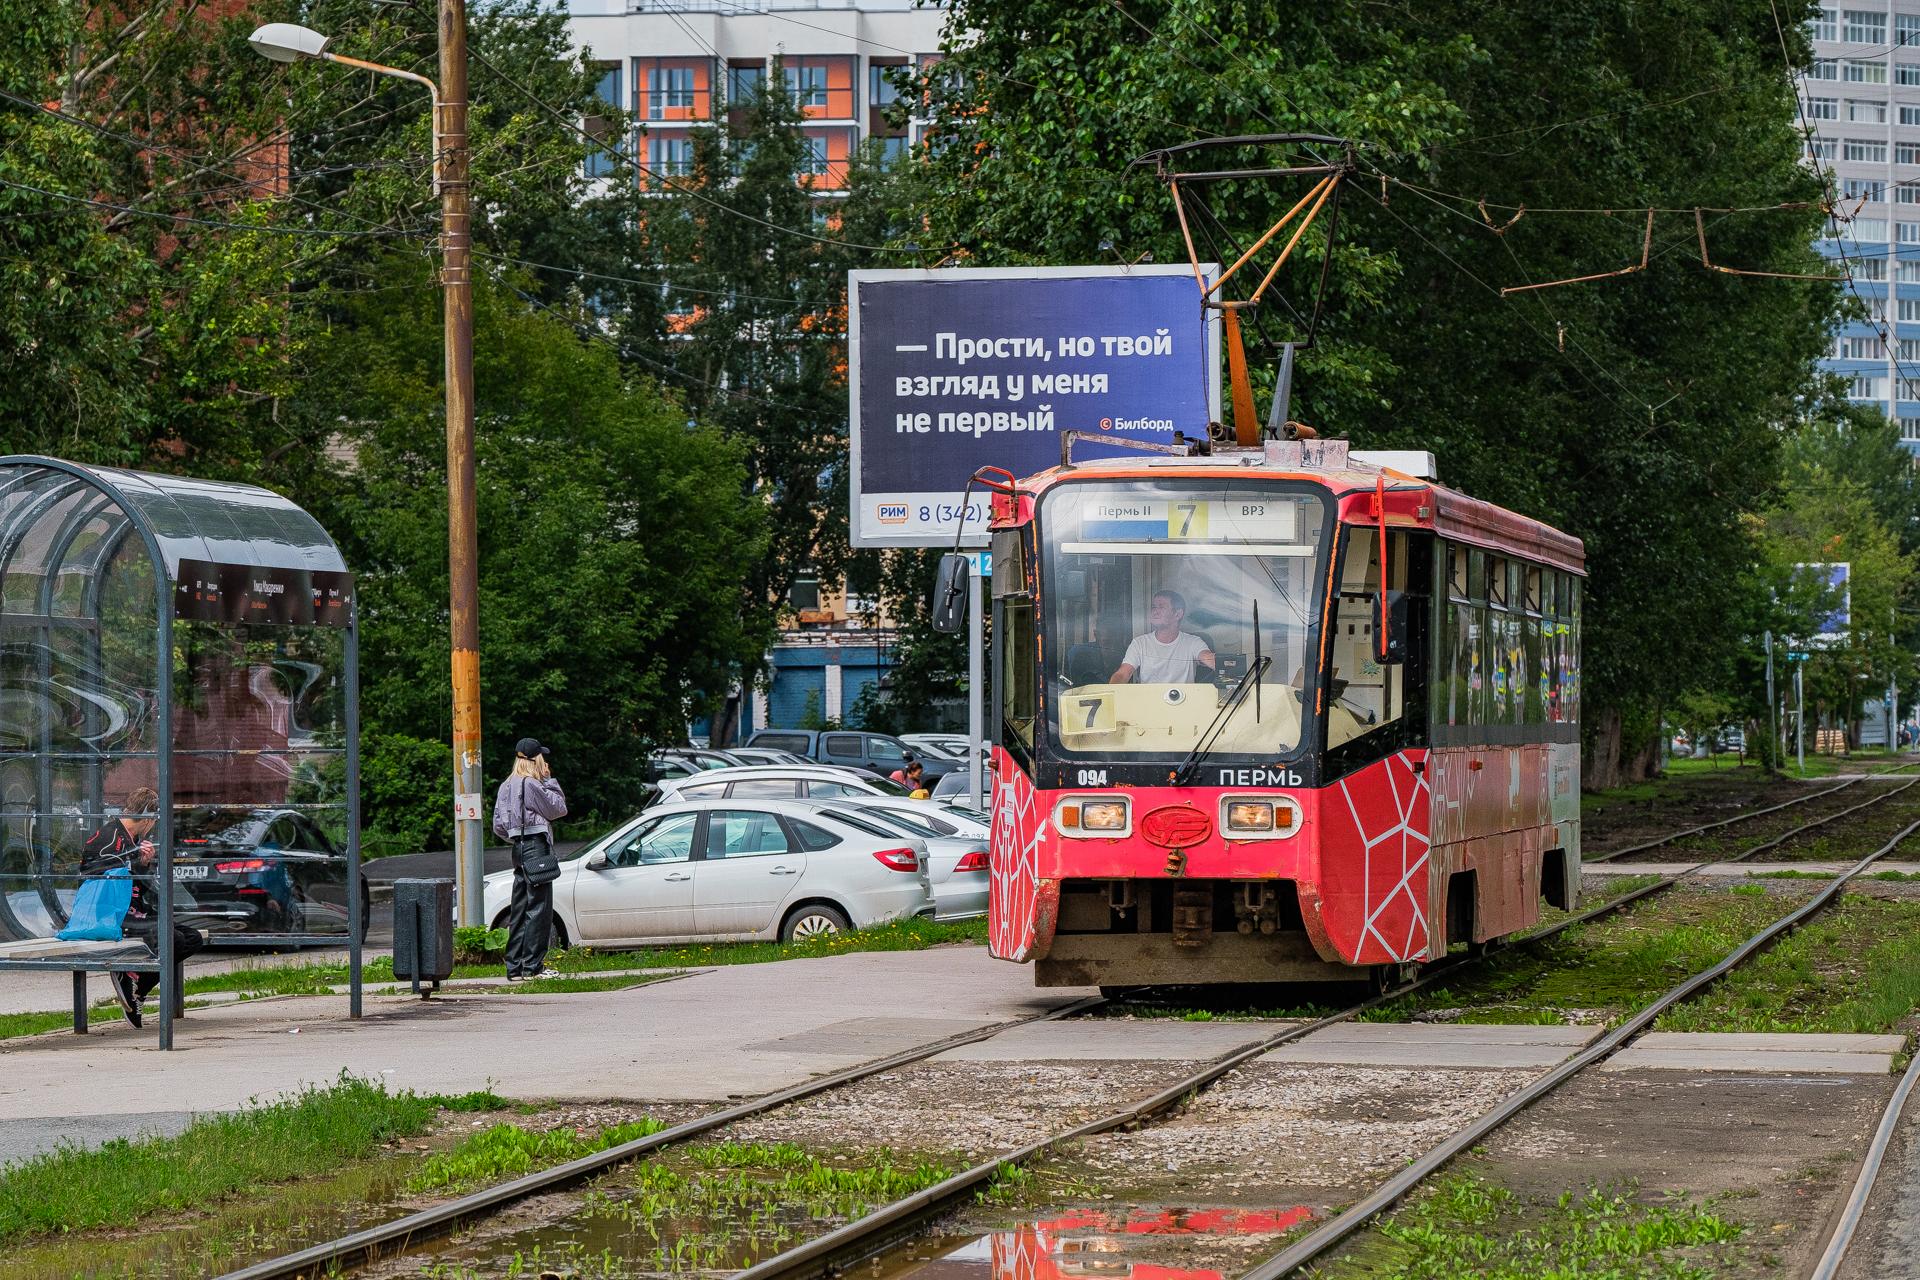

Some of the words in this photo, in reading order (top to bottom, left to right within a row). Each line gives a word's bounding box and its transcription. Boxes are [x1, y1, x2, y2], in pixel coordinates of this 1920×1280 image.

[935, 332, 1053, 365] Прости,
[1058, 336, 1096, 358] но
[1100, 328, 1172, 357] твой
[895, 375, 1001, 400] взгляд
[1006, 374, 1025, 402] у
[1031, 373, 1109, 395] меня
[896, 412, 932, 434] не
[938, 404, 1055, 439] первый
[1114, 416, 1174, 433] Билборд
[880, 507, 906, 518] РИМ
[919, 505, 931, 522] 8
[1098, 505, 1139, 519] Пермь
[1143, 505, 1151, 516] II
[1242, 505, 1265, 516] ВРЗ
[1177, 504, 1197, 537] 7
[1078, 699, 1102, 728] 7
[1077, 769, 1108, 786] 094
[1219, 769, 1303, 786] ПЕРМЬ
